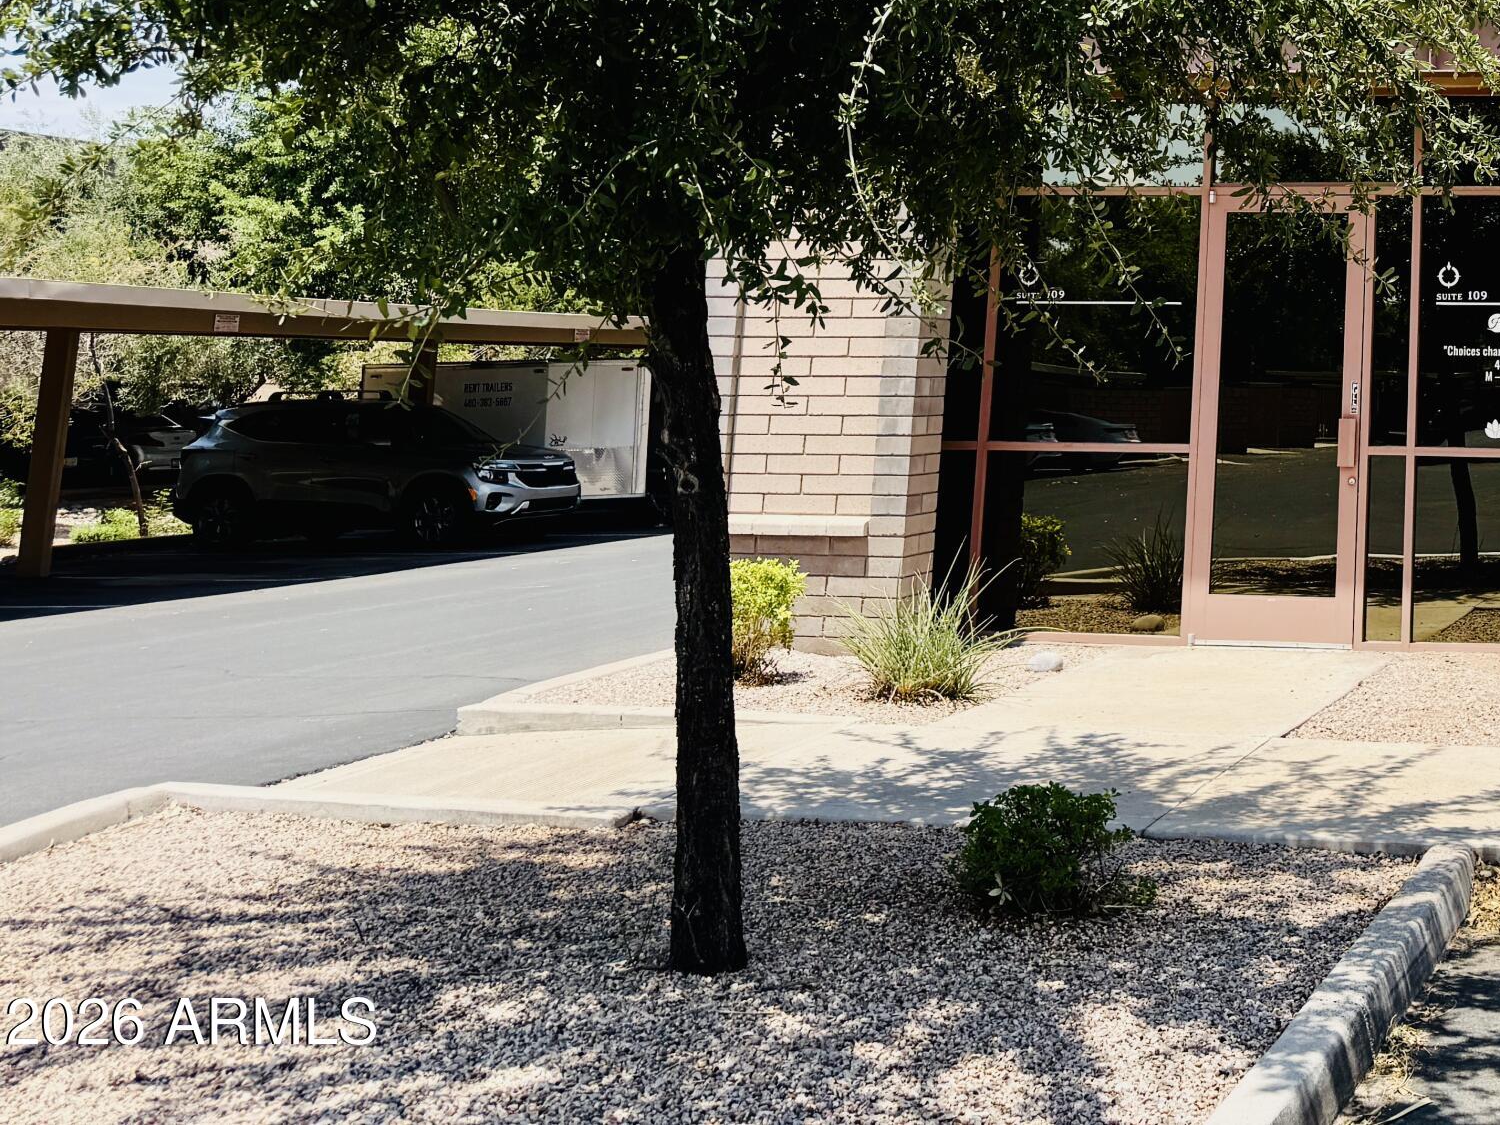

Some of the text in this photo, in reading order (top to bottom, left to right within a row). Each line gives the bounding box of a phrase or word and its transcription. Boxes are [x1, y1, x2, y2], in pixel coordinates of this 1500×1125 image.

[1436, 290, 1488, 301] SUITE 109
[1443, 345, 1480, 356] "Choices
[1485, 371, 1493, 382] M
